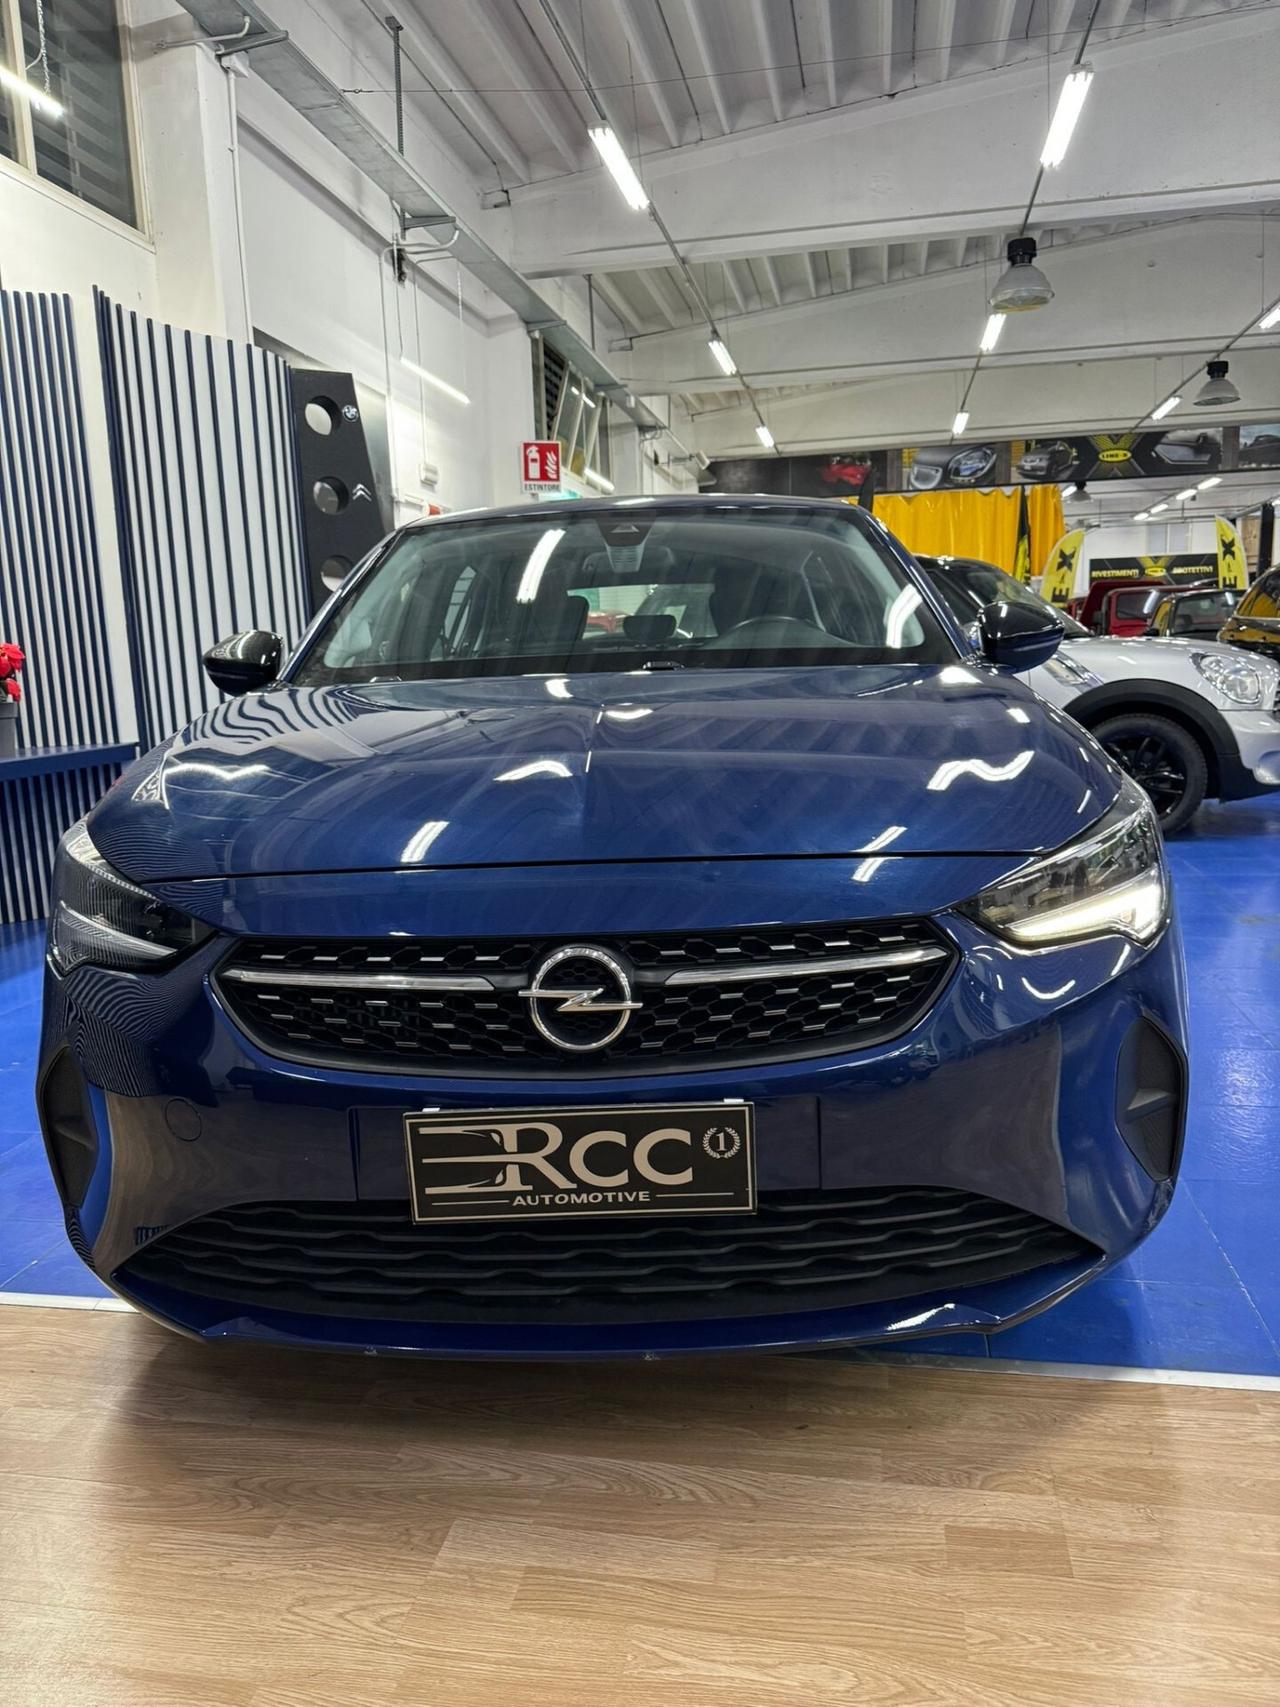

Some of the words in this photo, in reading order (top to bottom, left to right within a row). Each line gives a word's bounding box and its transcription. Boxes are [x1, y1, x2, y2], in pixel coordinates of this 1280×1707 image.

[523, 483, 560, 491] ESTINTORE
[715, 1132, 728, 1151] 1
[512, 1191, 651, 1206] AUTOMOTIVE
